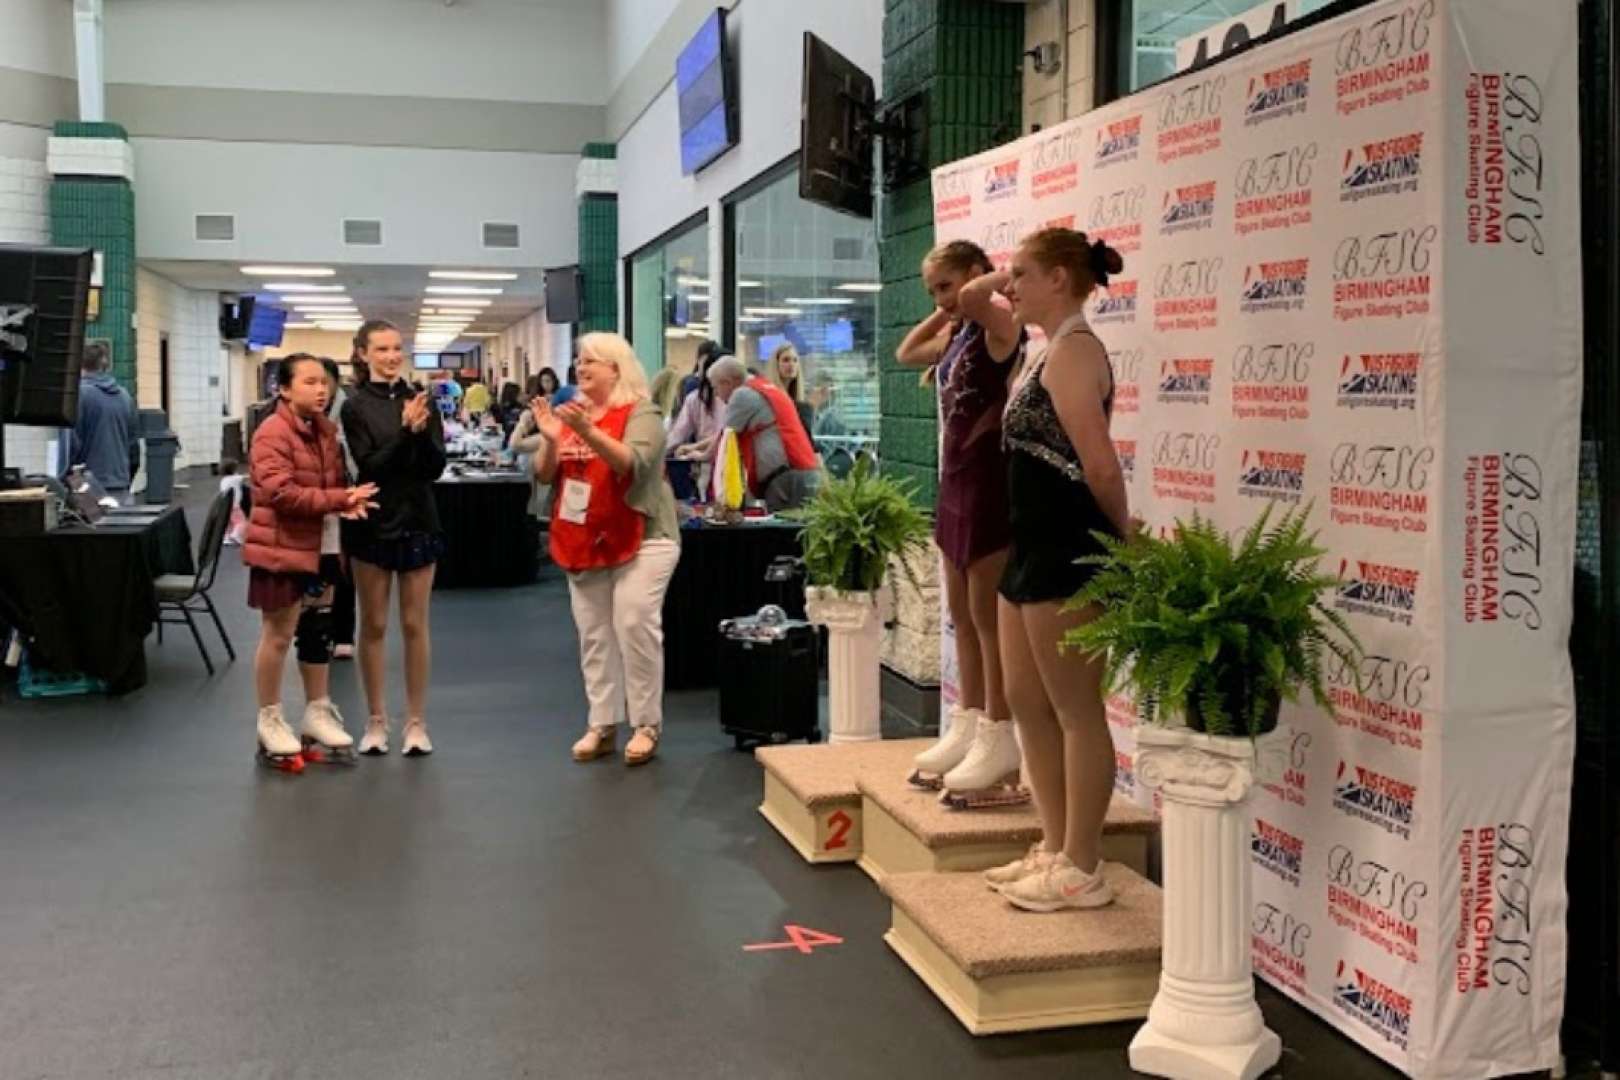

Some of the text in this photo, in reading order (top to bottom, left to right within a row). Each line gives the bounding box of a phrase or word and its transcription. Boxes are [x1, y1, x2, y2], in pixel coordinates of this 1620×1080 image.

[1337, 53, 1430, 97] BIRMINGHAM
[1336, 79, 1430, 117] Figure Skating Club
[1157, 118, 1222, 149] BIRMINGHAM
[1366, 154, 1420, 186] SKATING
[1465, 72, 1481, 244] Figure Skating Club
[1482, 73, 1504, 244] BIRMINGHAM
[1235, 189, 1312, 219] BIRMINGHAM
[1235, 211, 1312, 235] Figure Skating Club
[1333, 276, 1430, 304] BIRMINGHAM
[1154, 297, 1217, 317] BIRMINGHAM
[1333, 300, 1430, 321] Figure Skating Club
[1232, 385, 1309, 402] BIRMINGHAM
[1364, 373, 1417, 394] SKATING
[1232, 406, 1310, 421] Figure Skating Club
[1152, 466, 1215, 487] BIRMINGHAM
[1330, 486, 1428, 514] BIRMINGHAM
[1330, 511, 1427, 533] Figure Skating Club
[1480, 453, 1500, 622] BIRMINGHAM
[1462, 455, 1481, 624] Figure Skating Club
[1362, 583, 1415, 610] SKATING
[1328, 687, 1423, 731] BIRMINGHAM
[1361, 788, 1413, 824] SKATING
[825, 809, 854, 851] 2
[1328, 883, 1418, 946] BIRMINGHAM
[1456, 828, 1475, 994] Figure Skating Club
[1473, 825, 1497, 990] BIRMINGHAM
[742, 923, 845, 955] 4
[1328, 906, 1418, 964] Figure Skating Club
